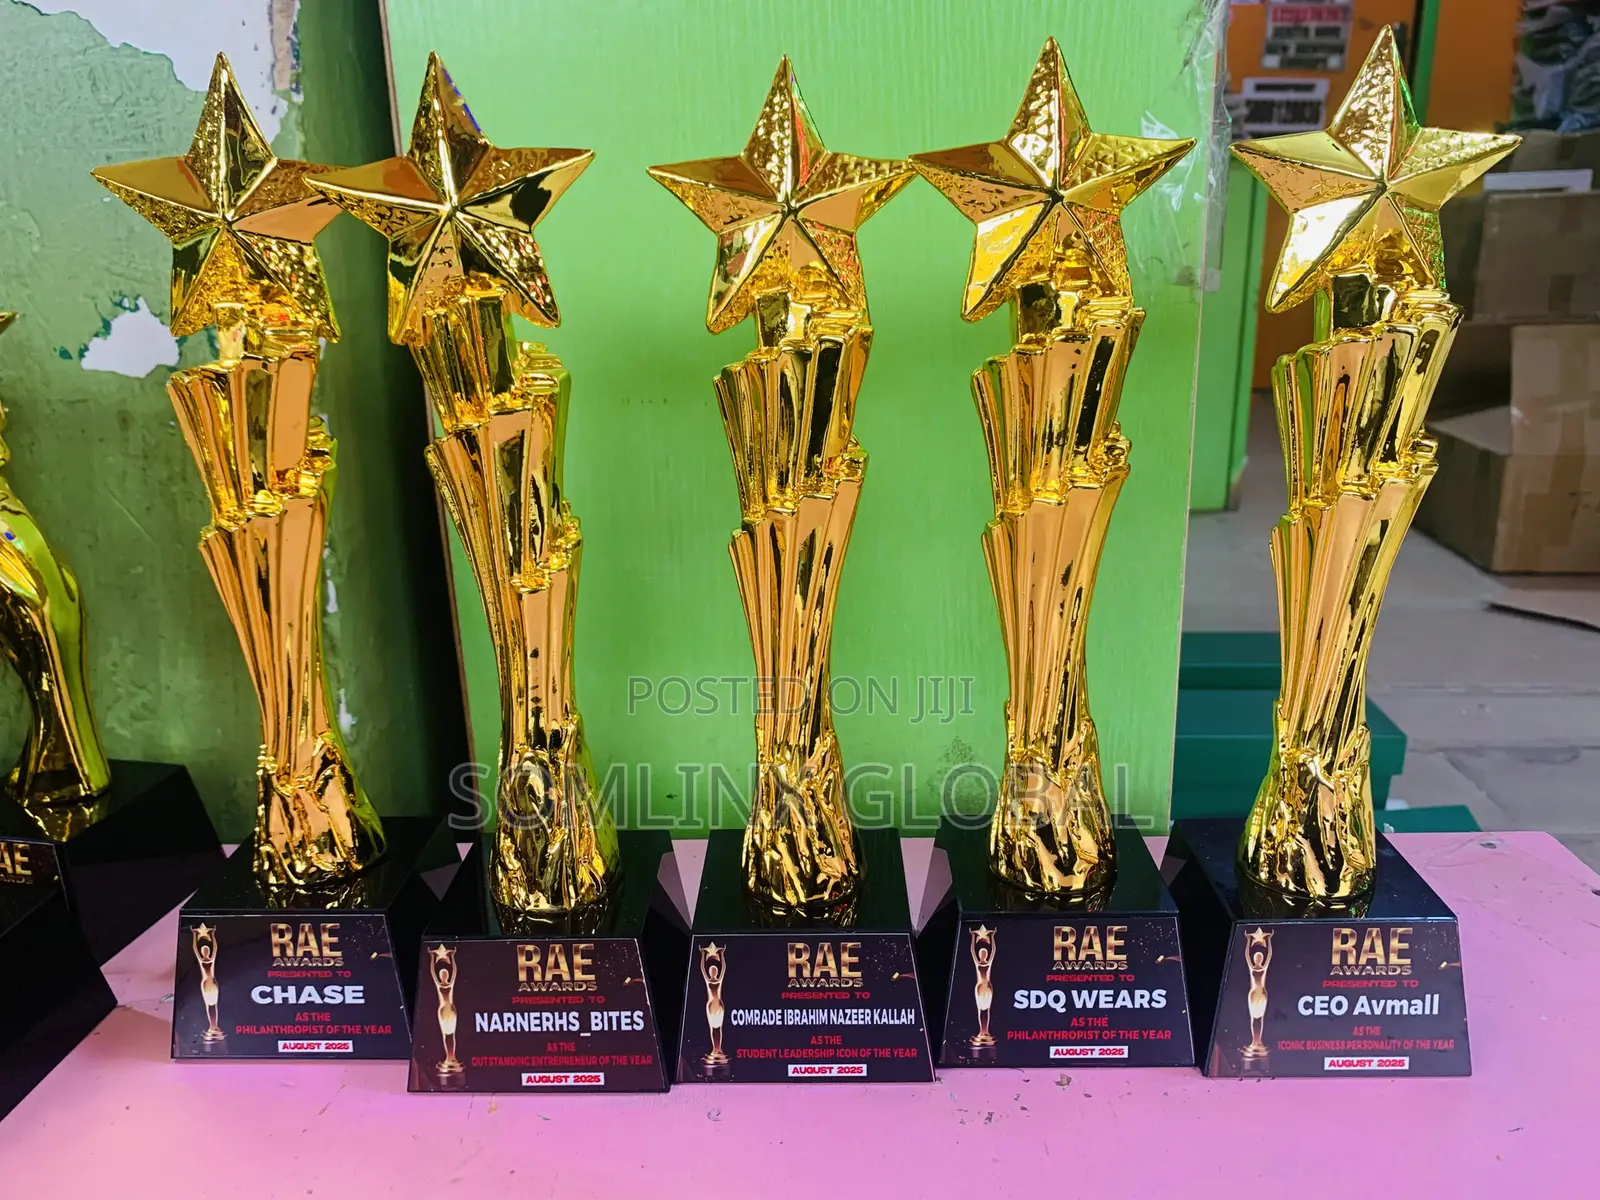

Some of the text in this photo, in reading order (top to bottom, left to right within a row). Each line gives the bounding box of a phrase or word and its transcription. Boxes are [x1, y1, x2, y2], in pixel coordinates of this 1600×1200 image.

[0, 842, 32, 875] AE
[270, 923, 343, 957] RAE
[1053, 925, 1128, 961] RAE
[1331, 927, 1413, 965] RAE
[272, 957, 345, 967] AWARDS
[516, 944, 596, 982] RAE
[787, 942, 862, 978] RAE
[1052, 961, 1128, 971] AWARDS
[1330, 965, 1412, 976] AWARDS
[267, 970, 352, 978] PRESENTED TO
[1046, 974, 1135, 982] PRESENTED TO
[517, 981, 598, 992] AWARDS
[787, 978, 864, 988] AWARDS
[1322, 980, 1419, 988] PRESENTED TO
[251, 985, 365, 1005] CHASE
[511, 996, 605, 1004] PRESENTED TO
[781, 991, 870, 1000] PRESENTED TO
[1013, 989, 1167, 1013] SDQ WEARS
[1297, 994, 1440, 1016] CEO Avmall
[295, 1012, 331, 1022] AS THE
[731, 1009, 915, 1026] COMRADE IBRAHIM NAZEER KALLAH
[1070, 1017, 1108, 1027] AS THE
[475, 1010, 645, 1037] NARNERHS_BITES
[235, 1025, 392, 1035] PHILANTHROPIST OF THE YEAR
[1353, 1026, 1381, 1036] AS THE
[810, 1035, 842, 1045] AS THE
[1007, 1031, 1172, 1041] PHILANTHROPIST OF THE YEAR
[282, 1042, 350, 1050] AUGUST 2025
[546, 1042, 576, 1052] AS THE
[1278, 1040, 1455, 1050] ICONIC BUSINESS PERSONALITY OF THE YEAR
[736, 1049, 917, 1058] STUDENT LEADERSHIP ICON OF THE YEAR
[1053, 1048, 1125, 1056] AUGUST 2025
[471, 1055, 653, 1066] OUTSTANDING ENTREPRENEUR OF THE YEAR
[1328, 1059, 1405, 1068] AUGUST 2025
[792, 1066, 863, 1075] AUGUST 2025
[526, 1075, 601, 1084] AUGUST 2025
